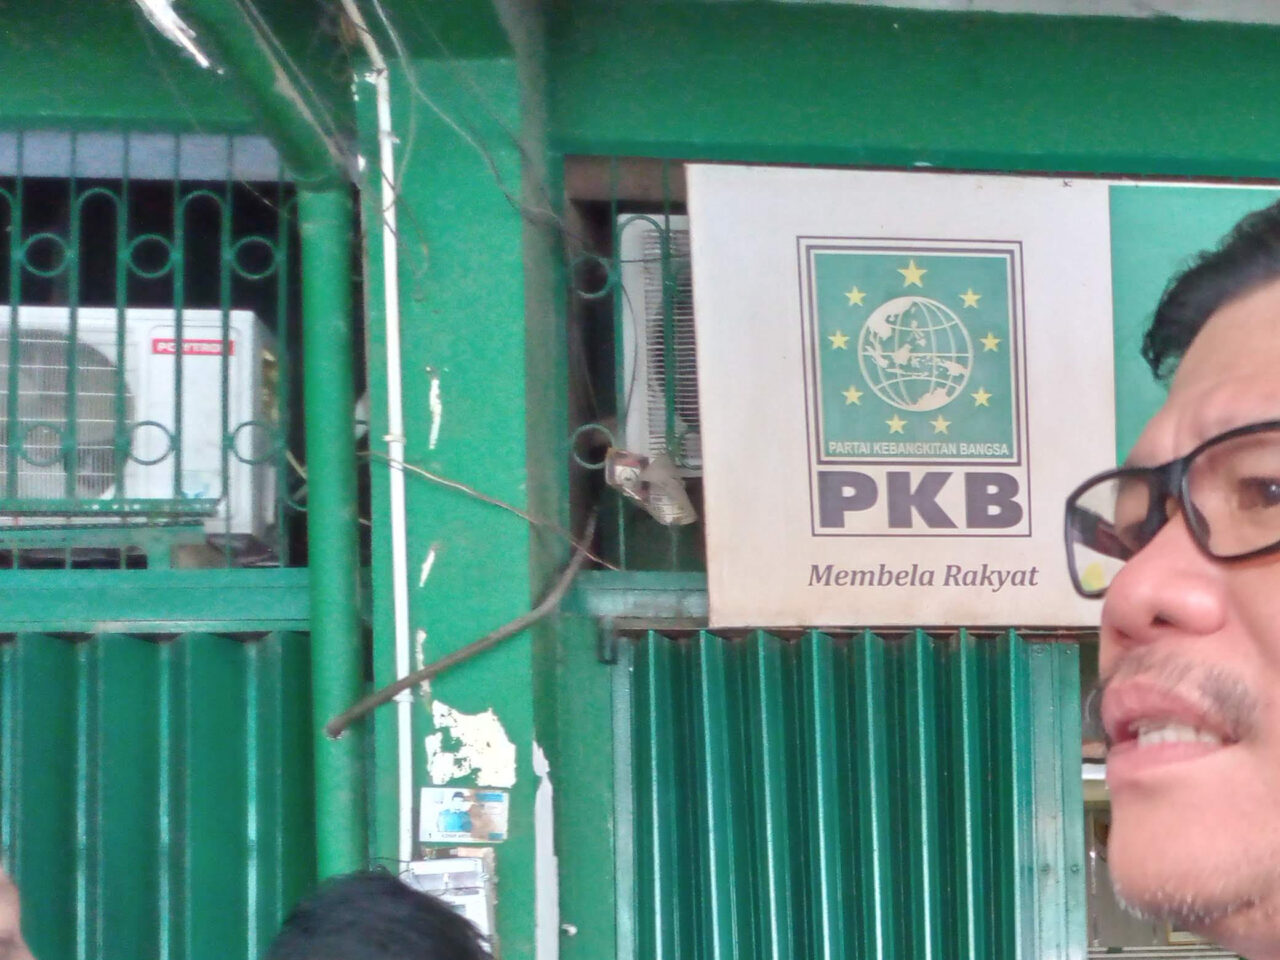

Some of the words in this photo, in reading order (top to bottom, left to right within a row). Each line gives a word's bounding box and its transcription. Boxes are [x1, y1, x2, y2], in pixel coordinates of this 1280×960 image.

[829, 441, 870, 454] PARTAI
[873, 442, 957, 455] KEBANGKITAN
[960, 442, 1009, 456] BANGSA
[817, 470, 1024, 529] PKB
[808, 564, 935, 587] Membela
[942, 563, 1040, 593] Rakyat
